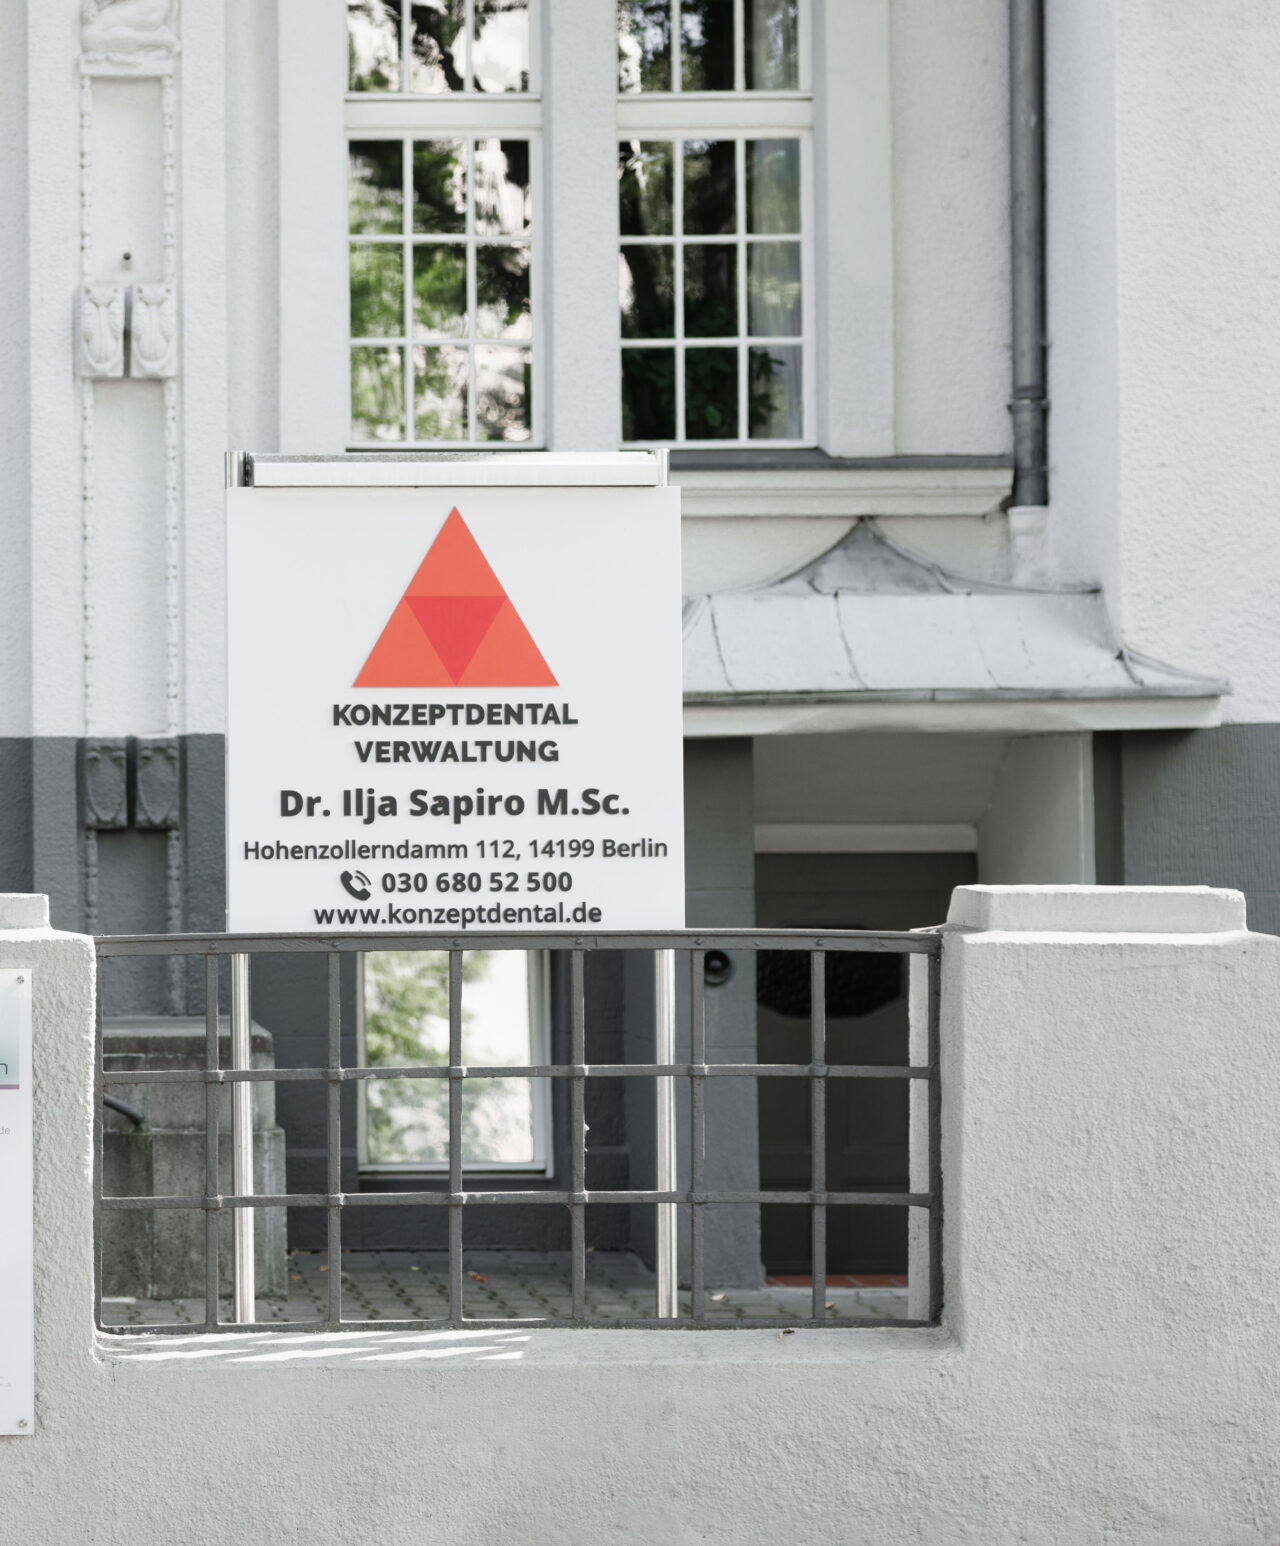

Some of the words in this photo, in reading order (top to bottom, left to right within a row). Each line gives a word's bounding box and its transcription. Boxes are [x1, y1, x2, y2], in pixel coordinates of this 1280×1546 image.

[332, 702, 579, 726] KONZEPTDENTAL
[354, 739, 560, 763] VERWALTUNG
[280, 789, 331, 818] Dr.
[342, 787, 398, 825] Ilja
[409, 787, 526, 824] Sapiro
[536, 787, 630, 816] M.Sc.
[243, 840, 469, 860] Hohenzollerndamm
[475, 840, 521, 861] 112,
[528, 839, 595, 859] 14199
[602, 838, 669, 858] Berlin
[381, 872, 429, 893] 030
[435, 872, 482, 893] 680
[488, 872, 520, 893] 52
[526, 871, 573, 893] 500
[313, 902, 603, 929] www.konzeptdental.de
